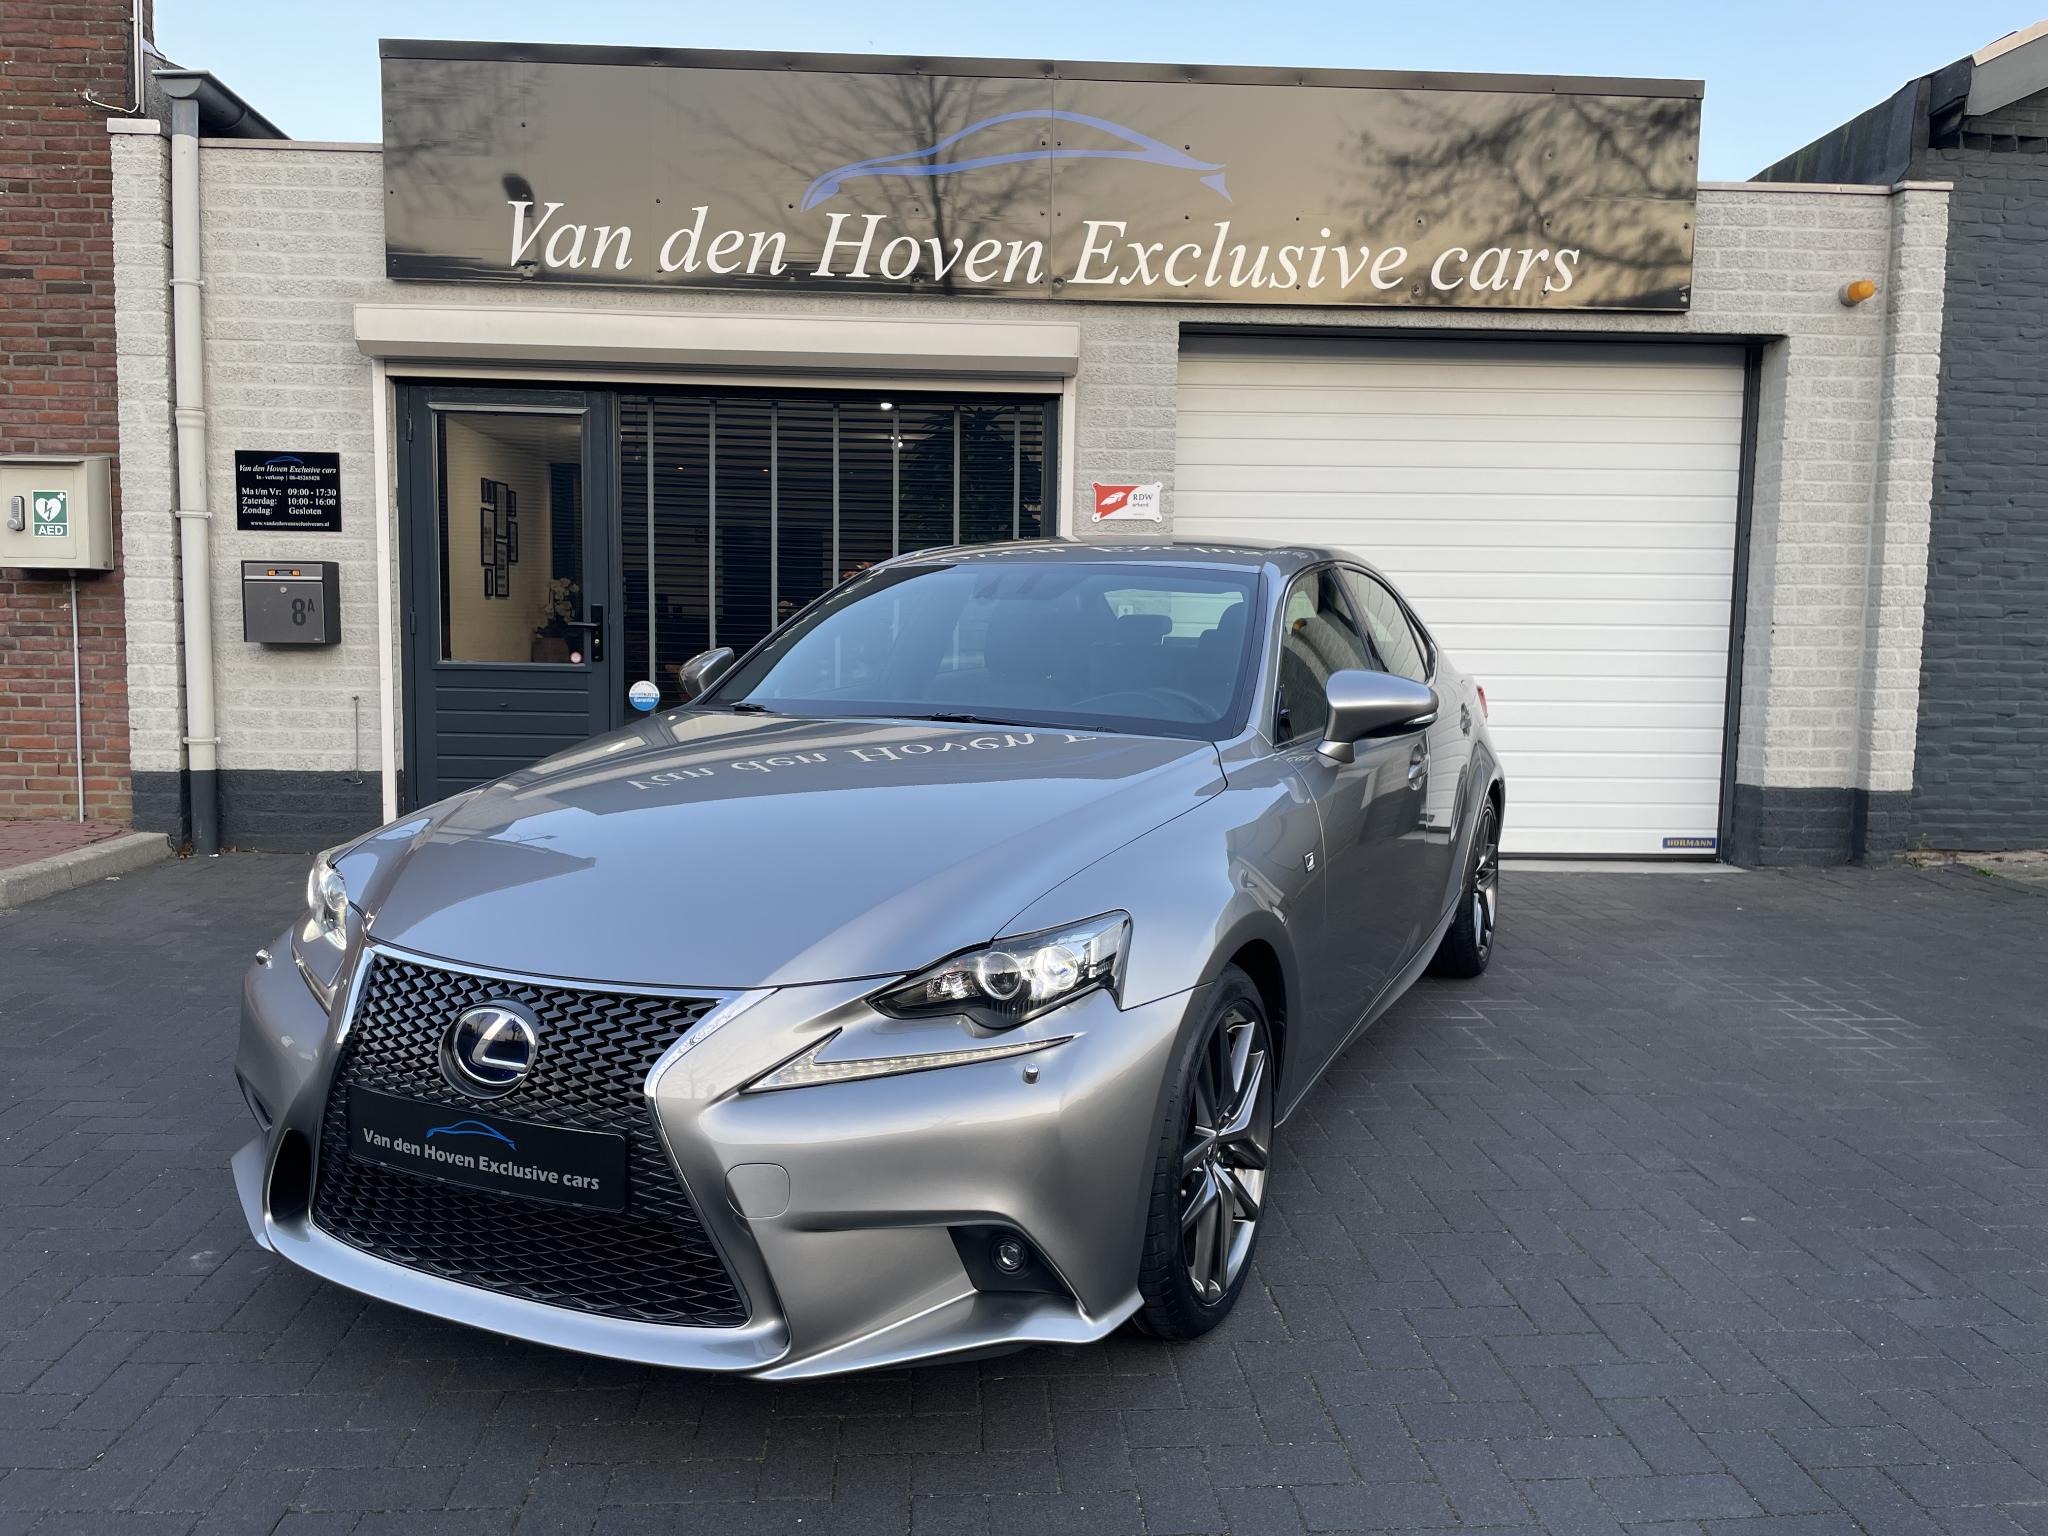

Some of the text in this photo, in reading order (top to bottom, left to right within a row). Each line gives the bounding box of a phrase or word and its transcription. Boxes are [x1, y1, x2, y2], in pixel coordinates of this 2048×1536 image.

[508, 200, 1580, 292] Van den Hoven Exclusive cars
[253, 465, 265, 473] den
[267, 465, 288, 473] Hoven
[290, 466, 321, 474] Exclusive
[287, 488, 310, 496] 09:00
[315, 489, 337, 497] 17:30
[1133, 493, 1154, 501] RDW
[241, 497, 278, 506] Zaterdag:
[287, 498, 309, 506] 10:00
[315, 498, 336, 506] 16:00
[242, 506, 322, 515] Zondag: Gesloten
[38, 525, 64, 536] AED
[363, 1127, 600, 1190] Van den Hoven Exclusive cars
